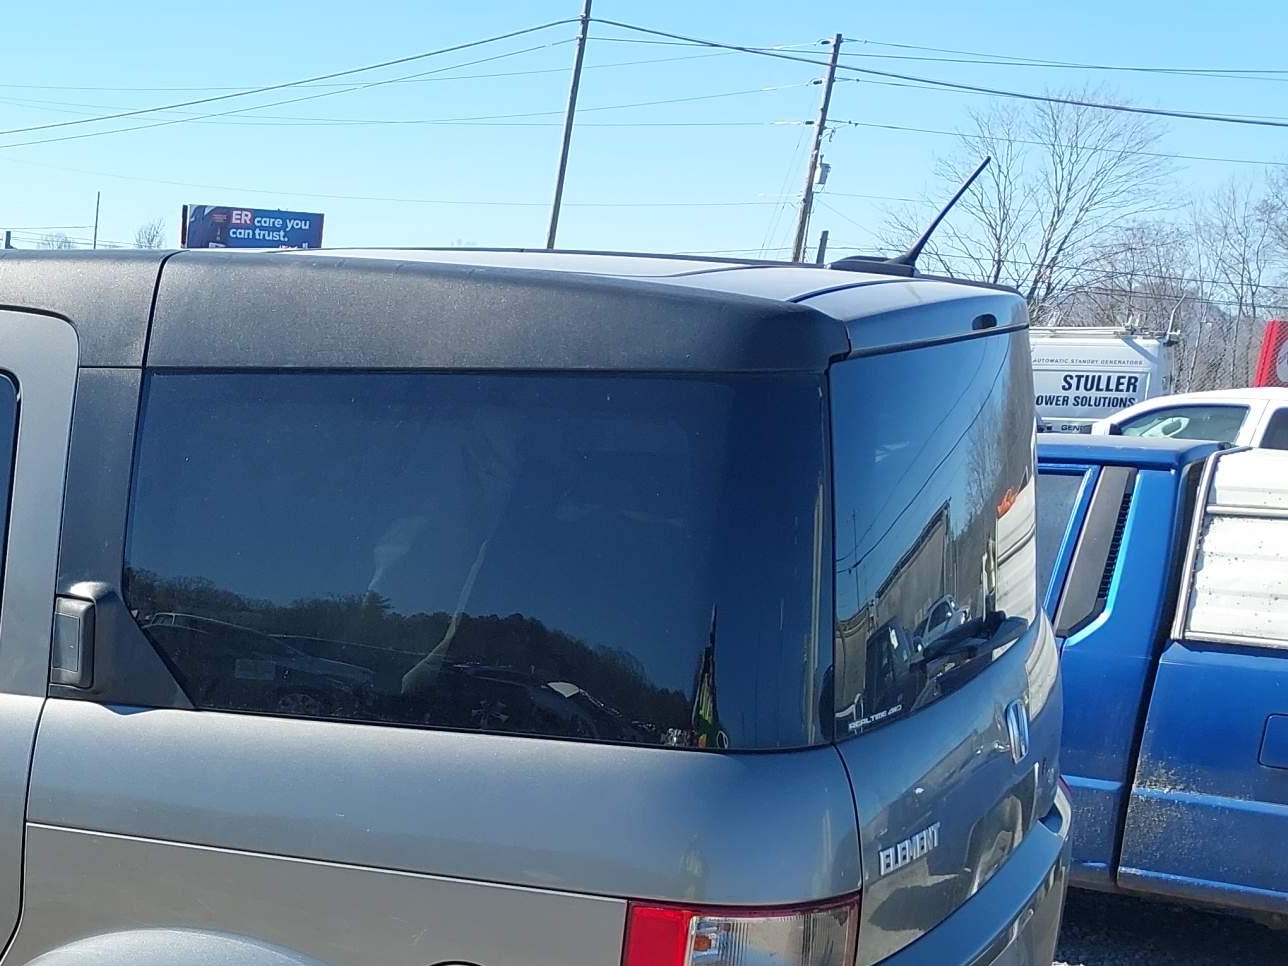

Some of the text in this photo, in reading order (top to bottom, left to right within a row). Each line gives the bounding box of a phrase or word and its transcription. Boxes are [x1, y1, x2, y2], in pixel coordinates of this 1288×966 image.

[231, 210, 252, 224] ER
[254, 217, 283, 228] care
[286, 219, 310, 231] you
[229, 228, 289, 242] can trust.
[1061, 374, 1139, 393] STULLER
[1035, 394, 1137, 408] OWER SOLUTIONS
[879, 821, 942, 877] ELEMENT
